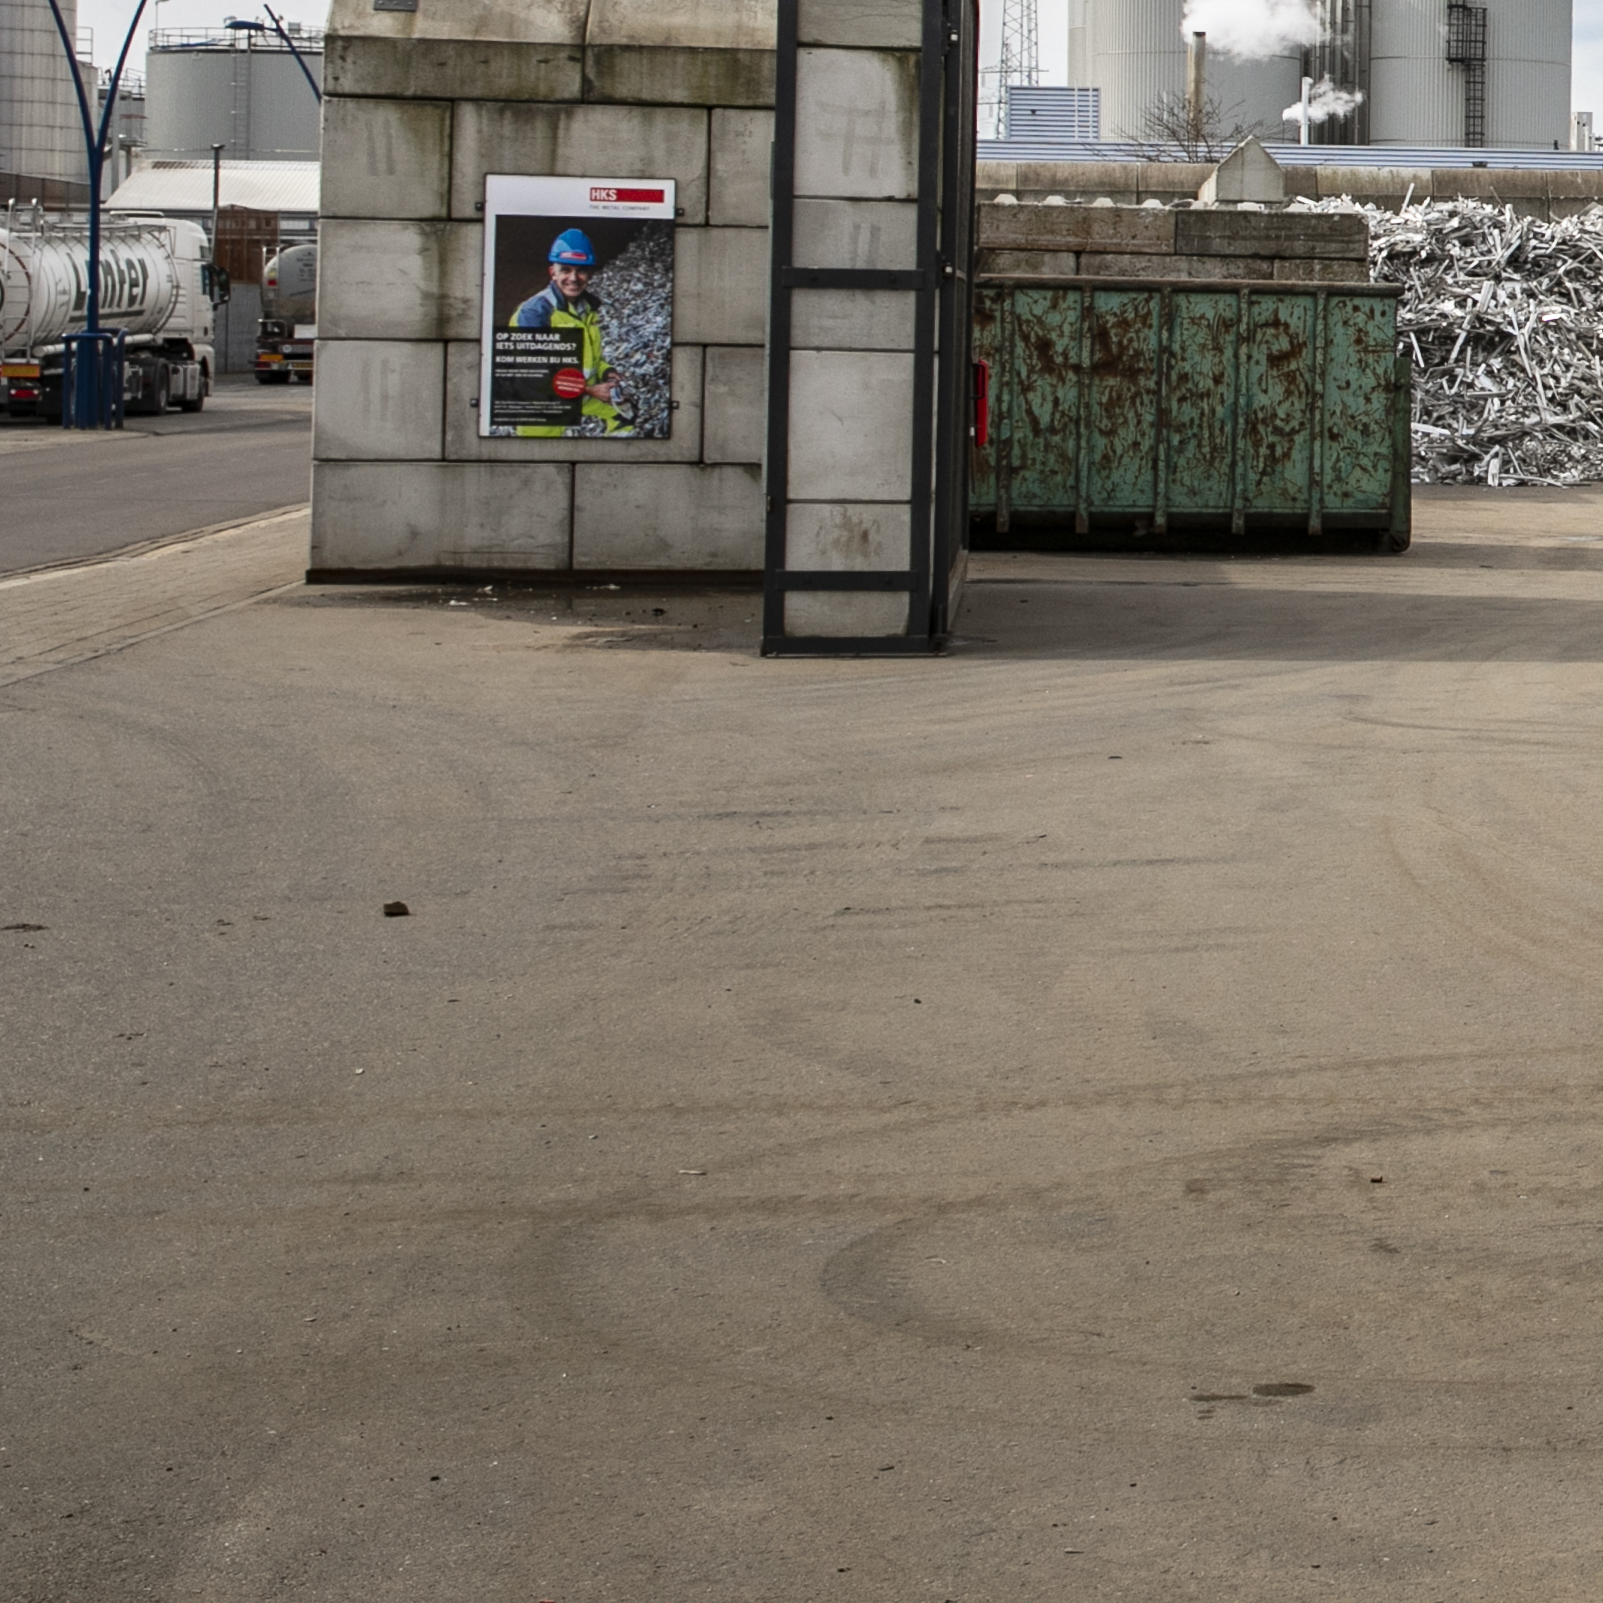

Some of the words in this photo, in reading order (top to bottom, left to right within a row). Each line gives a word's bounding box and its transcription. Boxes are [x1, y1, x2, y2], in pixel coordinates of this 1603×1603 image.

[591, 189, 618, 201] HKS
[66, 248, 149, 311] Lnter
[495, 333, 509, 341] OP
[510, 333, 534, 341] ZOEK
[535, 333, 561, 341] NAAR
[495, 342, 514, 350] IETS
[516, 342, 577, 351] UITDAGENDS?
[515, 356, 548, 364] WERKEN
